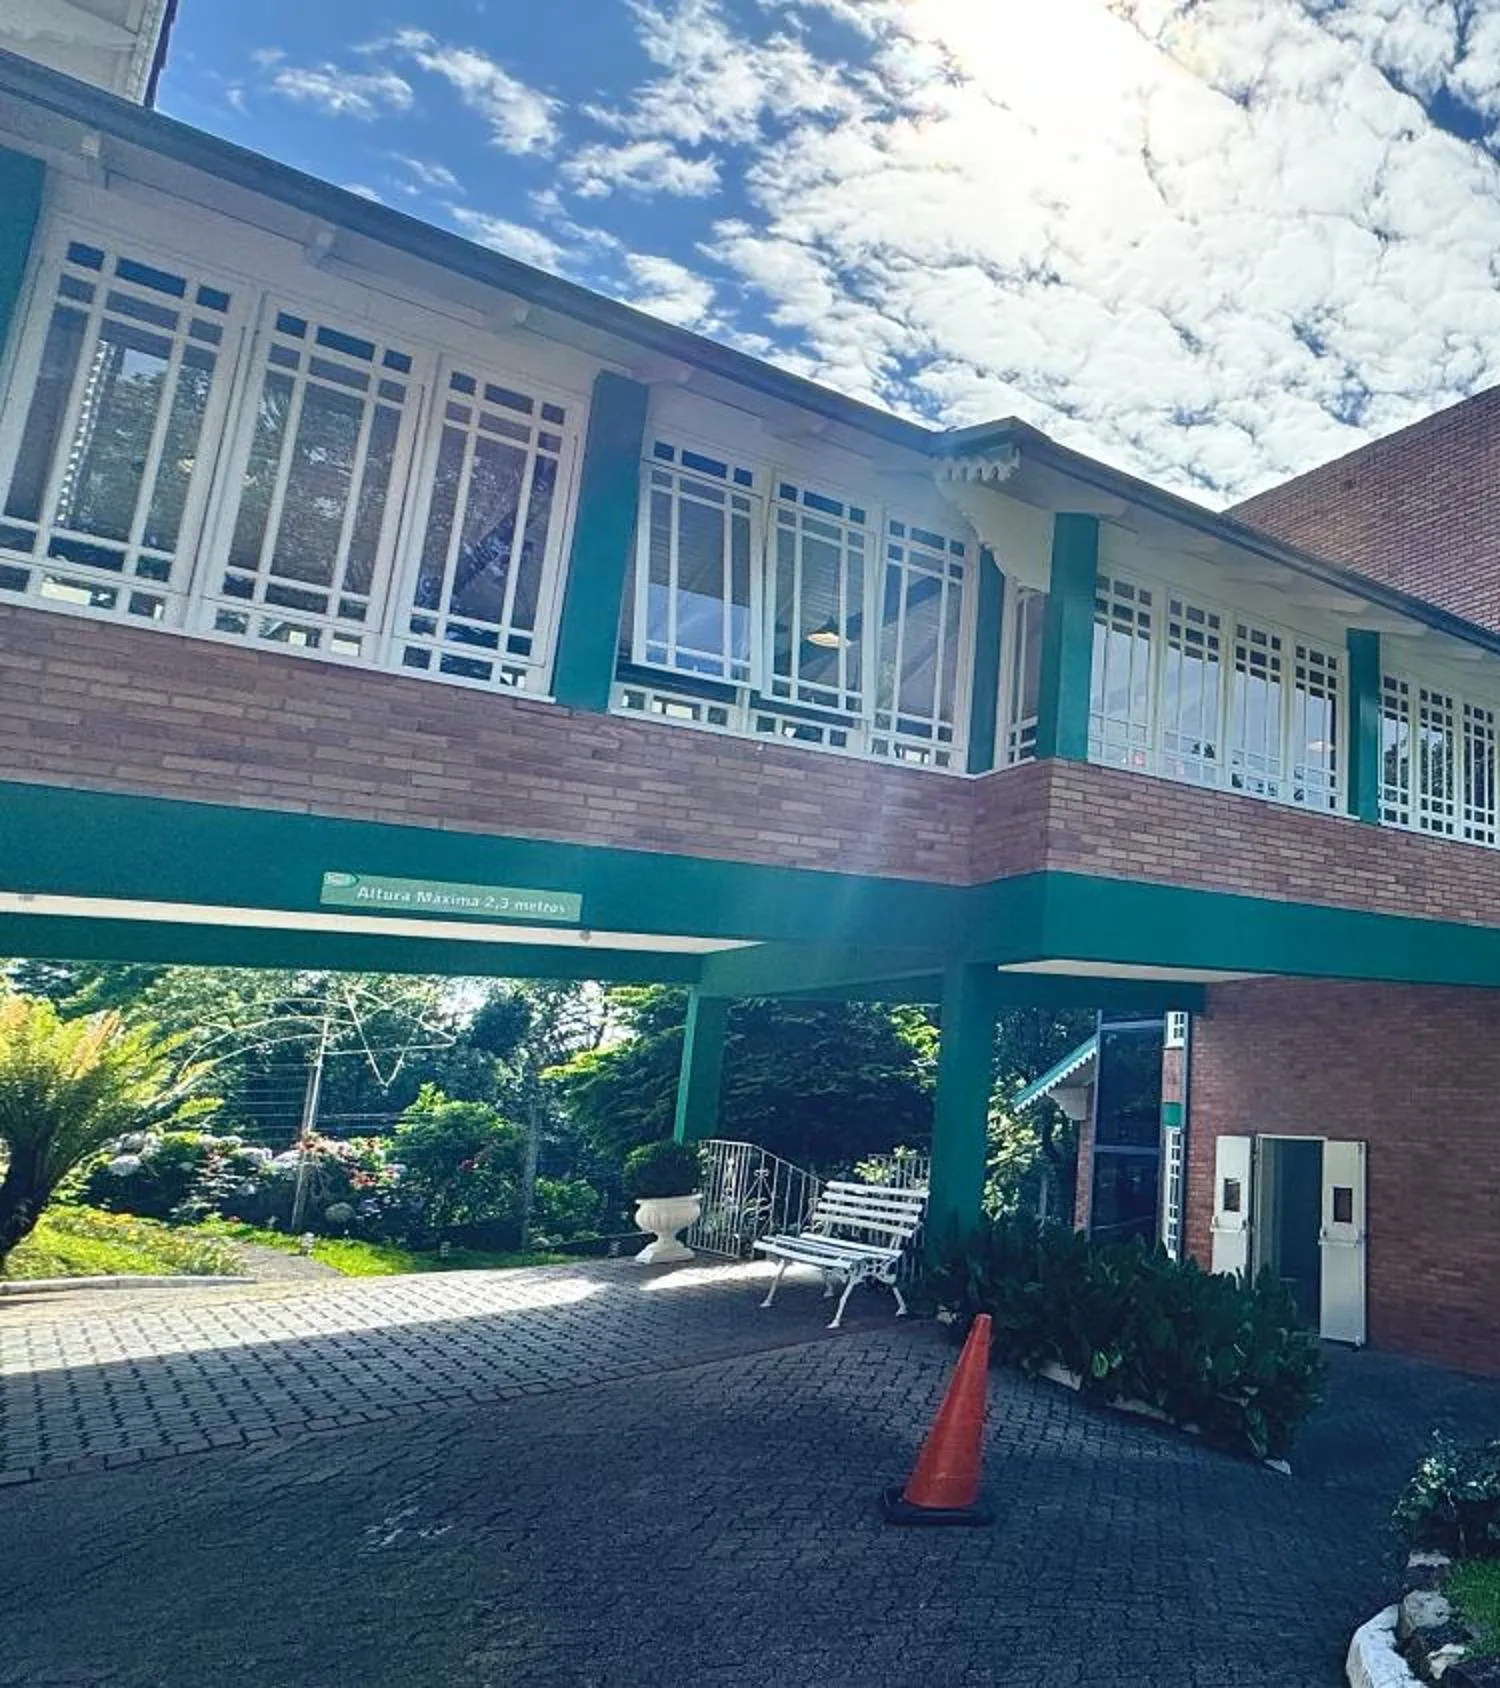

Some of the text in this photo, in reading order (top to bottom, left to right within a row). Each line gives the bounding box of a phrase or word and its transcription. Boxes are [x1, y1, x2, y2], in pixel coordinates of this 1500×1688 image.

[356, 886, 411, 902] Altura
[483, 895, 510, 911] 2,3
[514, 900, 566, 914] metros
